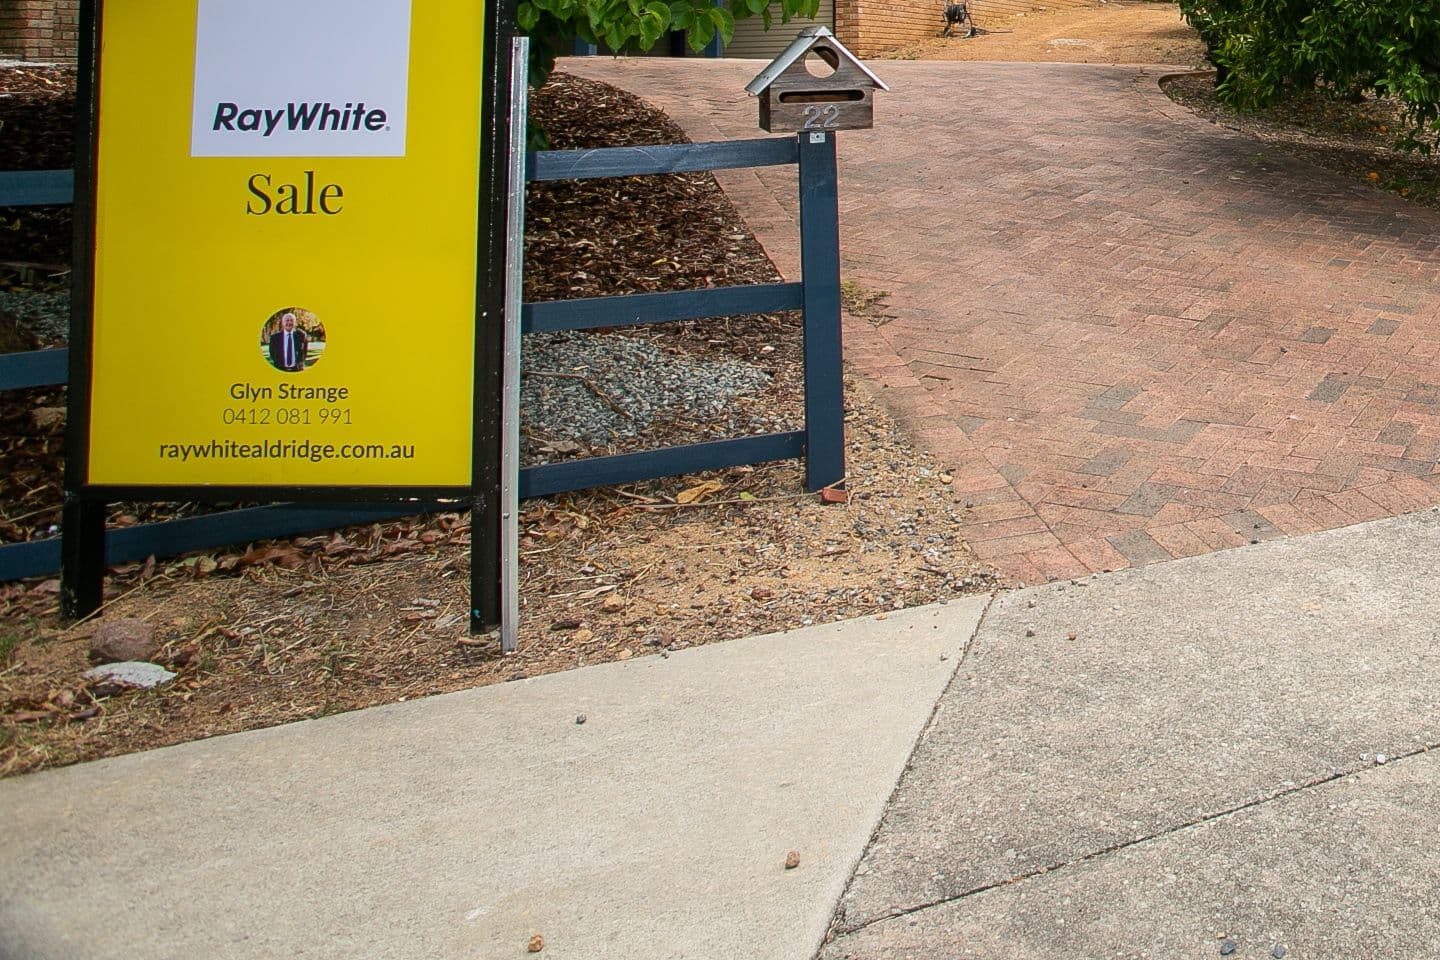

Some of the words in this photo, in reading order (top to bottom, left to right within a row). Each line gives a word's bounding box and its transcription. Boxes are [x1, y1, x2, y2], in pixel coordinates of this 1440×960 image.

[804, 104, 840, 129] 22
[246, 170, 344, 216] Sale
[230, 382, 272, 403] Glyn
[278, 382, 349, 403] Strange
[222, 408, 271, 425] 0412
[276, 408, 312, 425] 081
[318, 408, 353, 425] 991
[158, 439, 415, 463] raywhitealdridge.com.au
